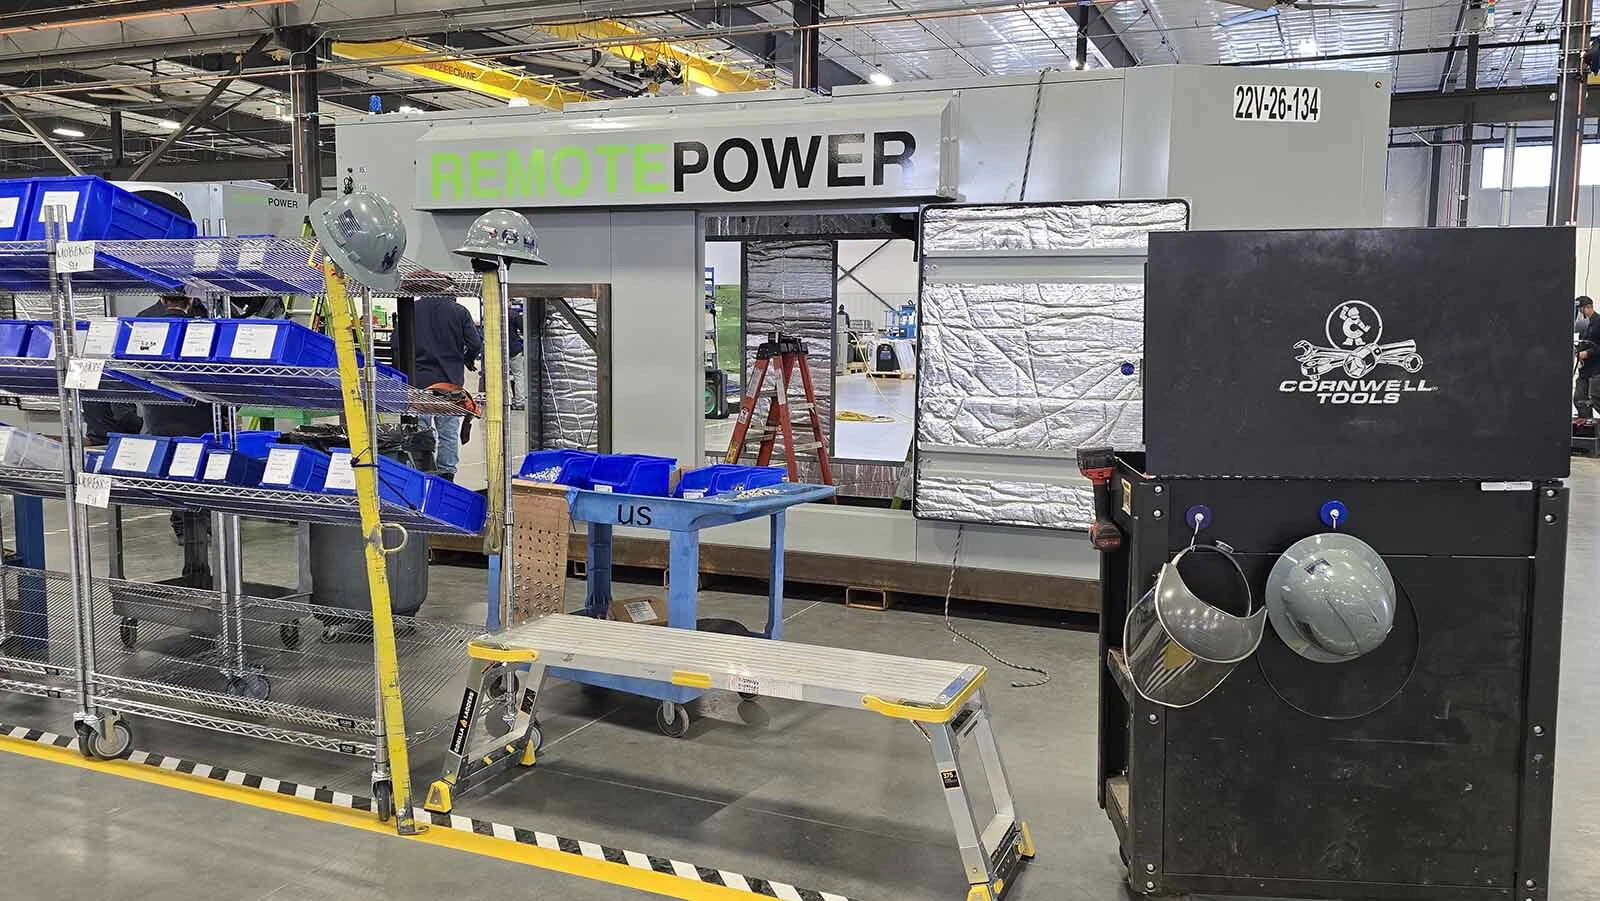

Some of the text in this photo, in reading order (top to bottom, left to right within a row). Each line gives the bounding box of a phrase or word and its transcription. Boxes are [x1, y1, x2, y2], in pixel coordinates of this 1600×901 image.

[1235, 85, 1318, 121] 22V-26-134
[267, 197, 298, 209] POWER
[1279, 379, 1433, 392] CORNWELL
[1316, 392, 1401, 404] TOOLS
[454, 691, 475, 753] GORILLA LADDERS
